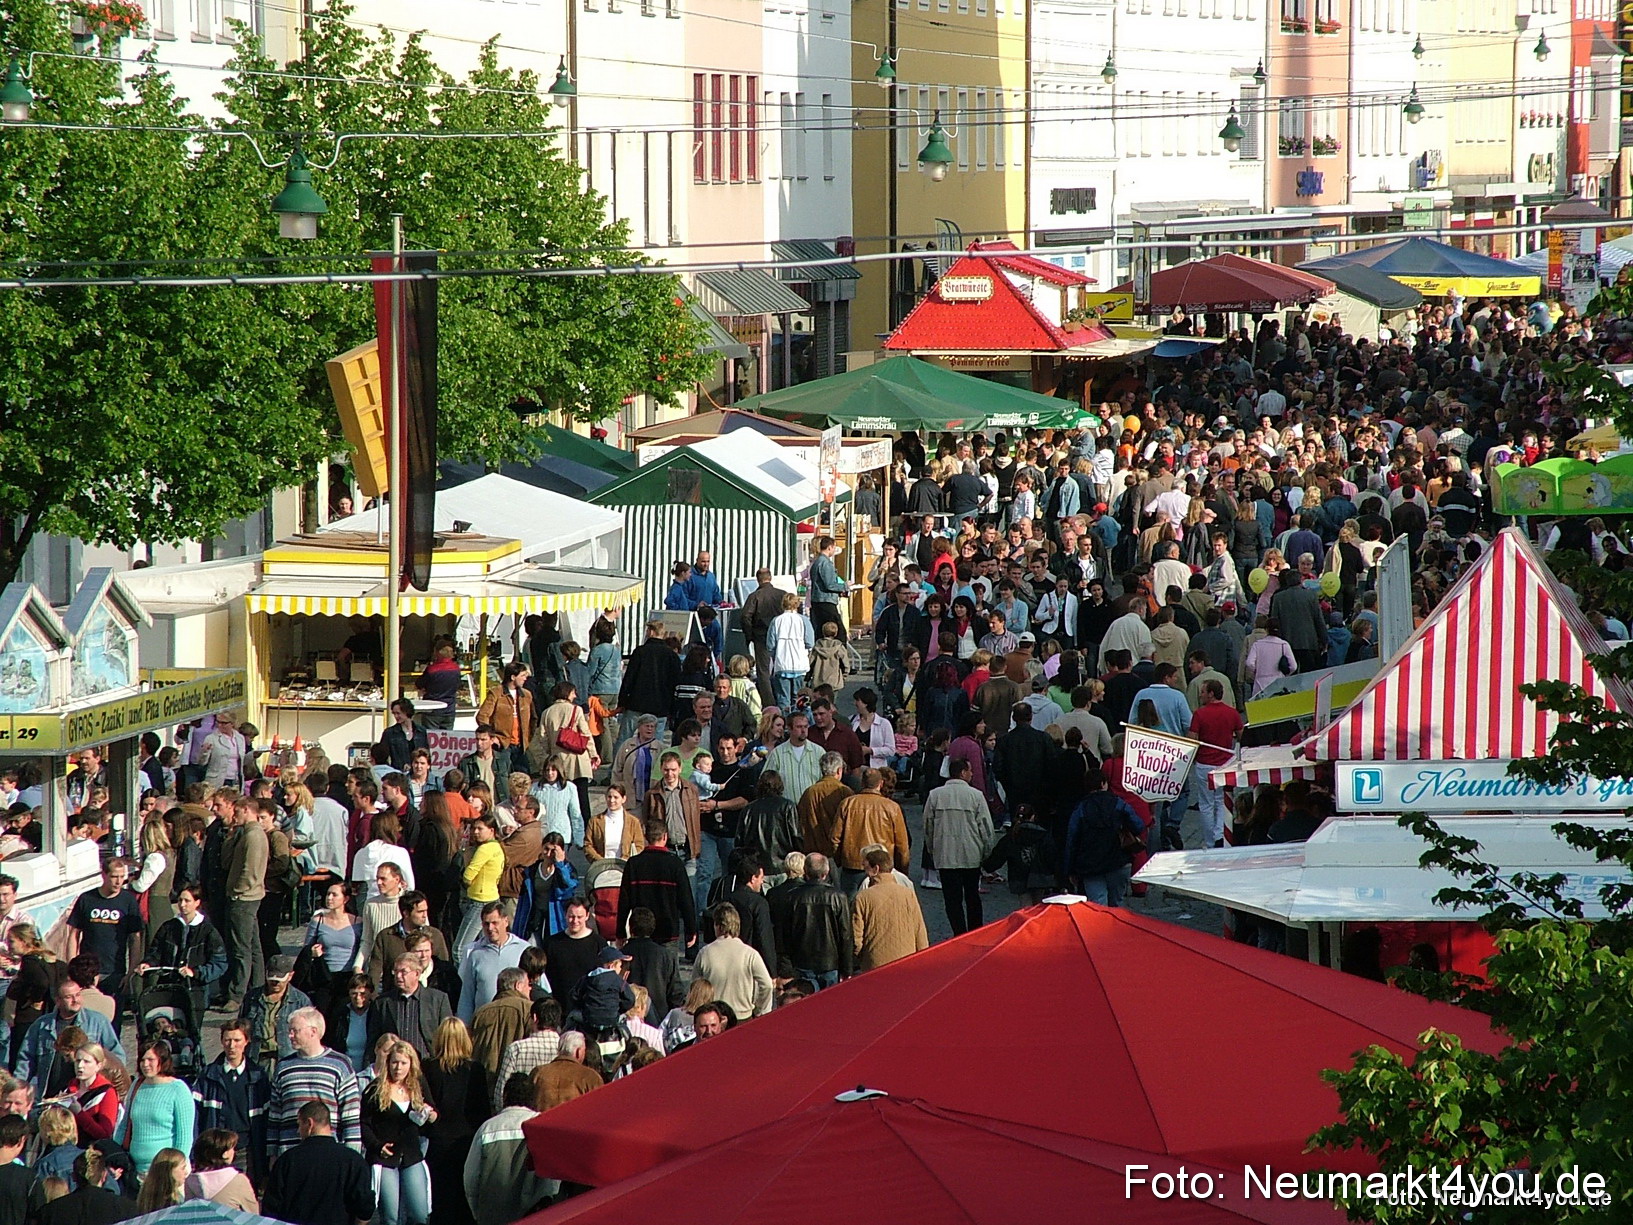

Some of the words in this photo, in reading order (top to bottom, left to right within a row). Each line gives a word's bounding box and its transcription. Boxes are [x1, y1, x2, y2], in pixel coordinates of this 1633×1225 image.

[944, 280, 988, 293] Bratwürste
[69, 712, 94, 743] GYROS
[128, 703, 143, 725] und
[146, 699, 159, 721] Pita
[163, 688, 202, 717] Griechische
[203, 678, 243, 710] Spezialitäten
[17, 728, 39, 740] 29
[427, 731, 478, 751] Döner
[1130, 739, 1189, 762] Ofenfrische
[1137, 750, 1177, 775] Knobi-
[1124, 766, 1182, 795] Baguettes
